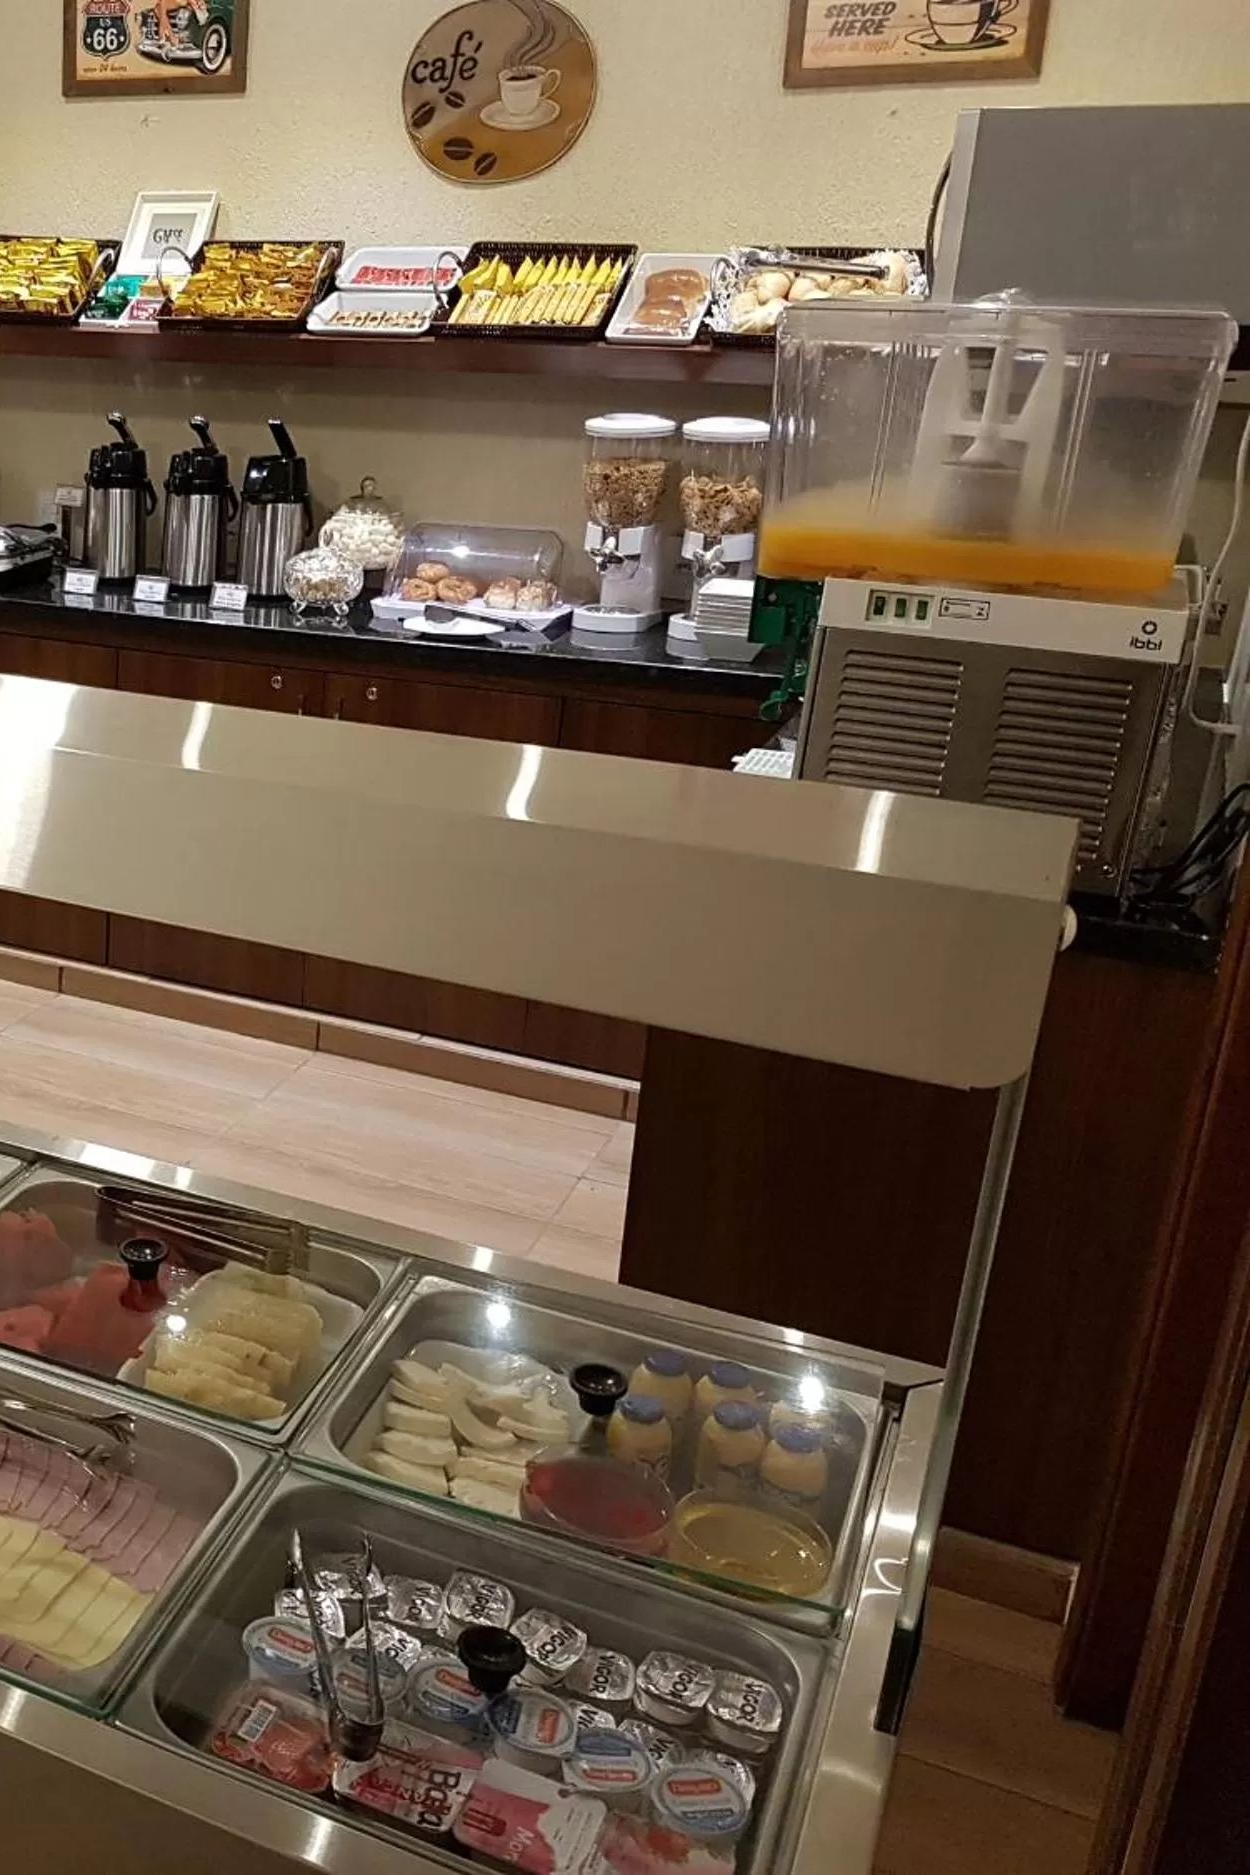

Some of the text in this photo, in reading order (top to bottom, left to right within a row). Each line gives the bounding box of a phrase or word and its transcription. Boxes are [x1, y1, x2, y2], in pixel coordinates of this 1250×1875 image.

[824, 1, 897, 19] SERVED
[92, 28, 118, 51] 66
[828, 17, 891, 37] HERE
[411, 30, 482, 94] café
[589, 1654, 616, 1694] VIGOR
[736, 1683, 763, 1723] VIGOR
